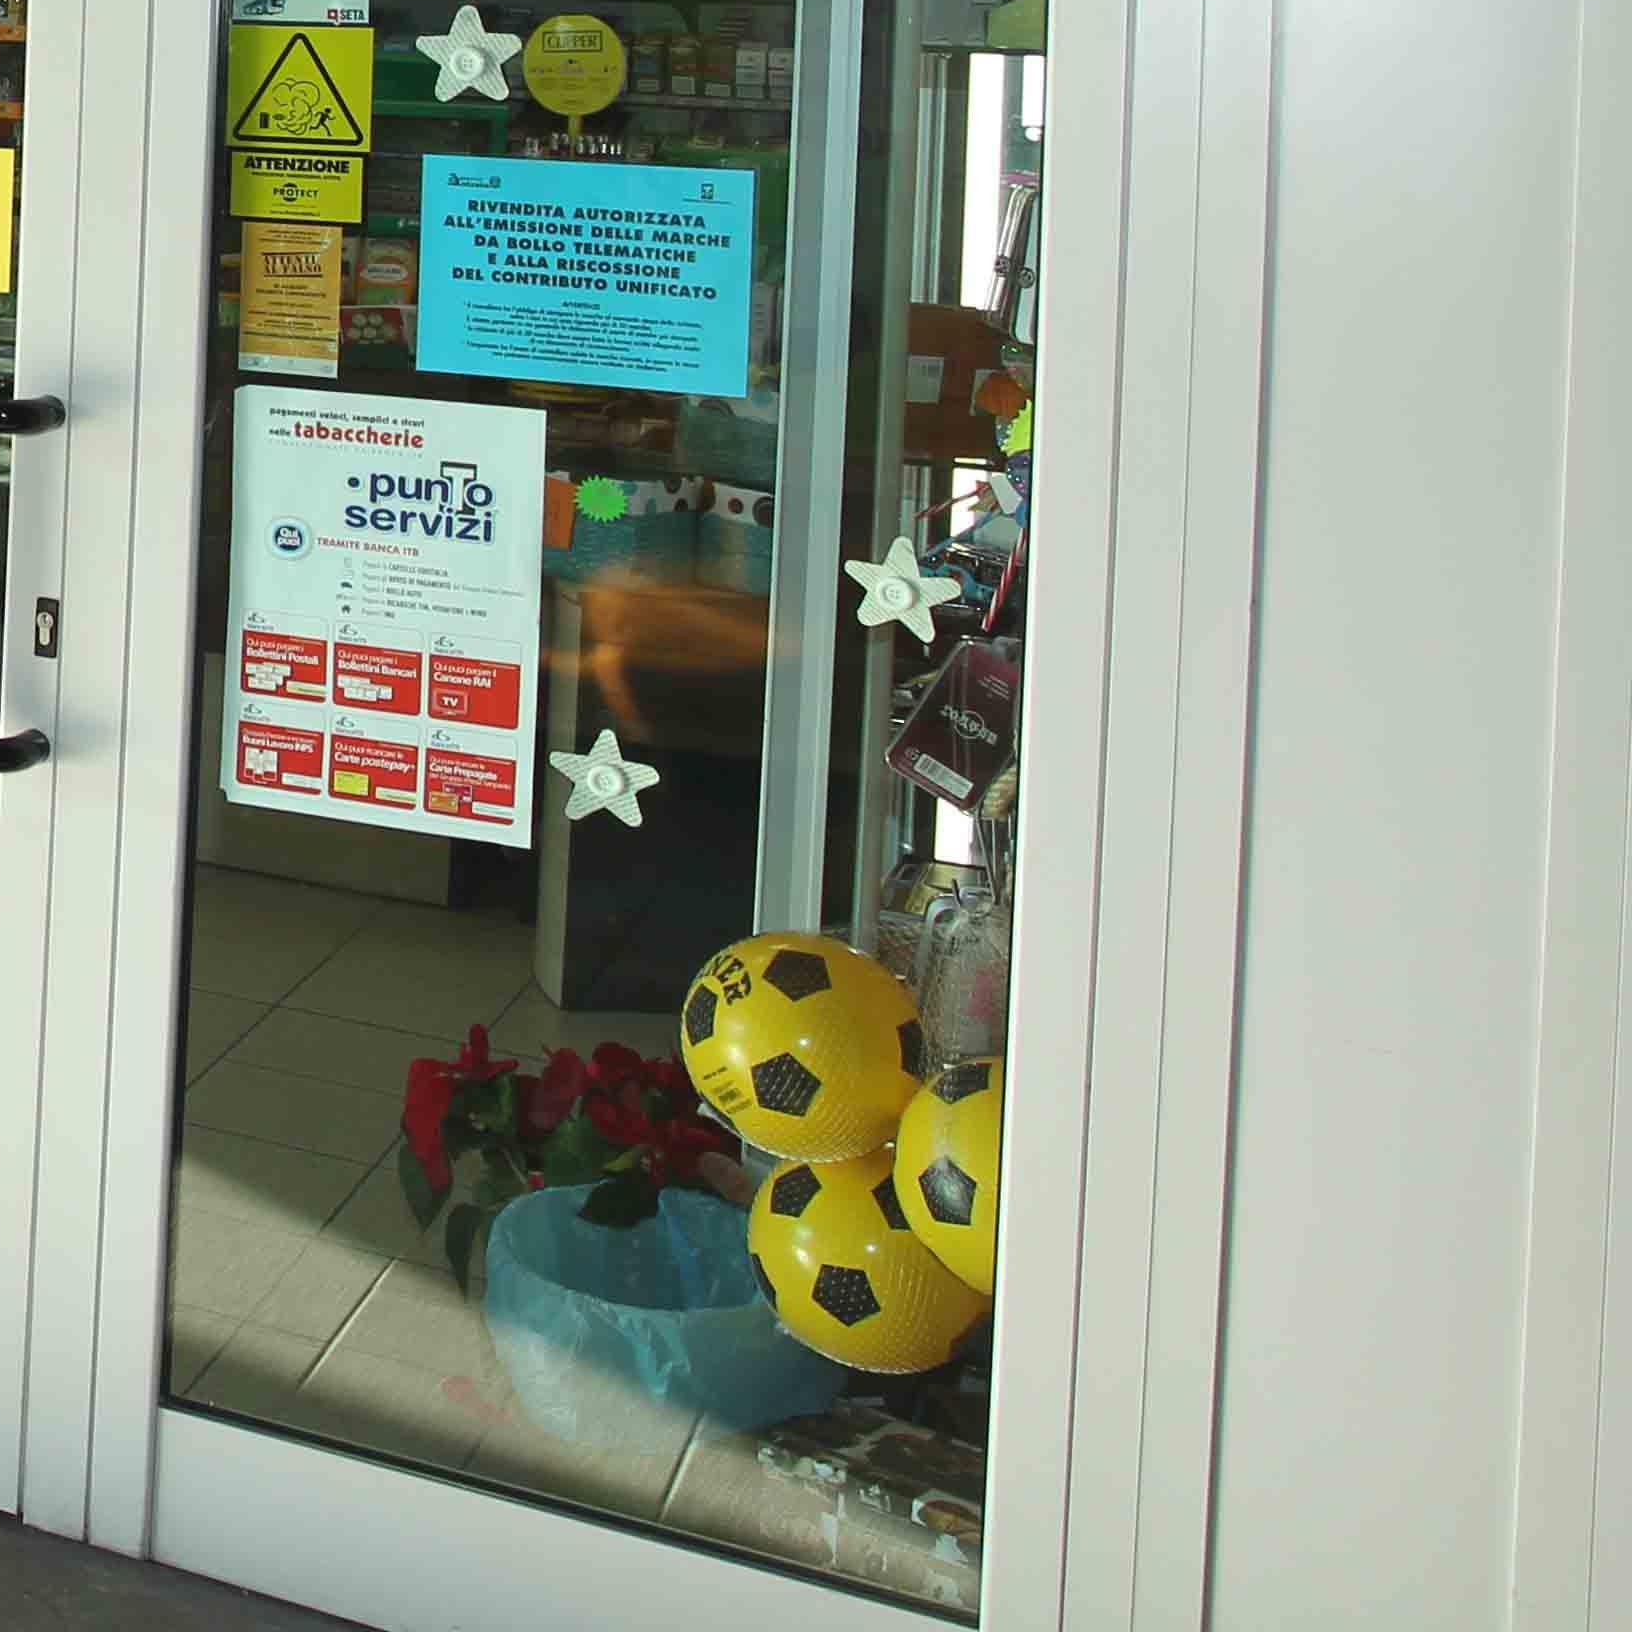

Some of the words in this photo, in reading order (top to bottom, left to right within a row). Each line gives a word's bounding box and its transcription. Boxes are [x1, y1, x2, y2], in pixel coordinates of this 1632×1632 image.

[339, 9, 365, 20] SETA
[244, 156, 350, 174] ATTENZIONE
[468, 199, 564, 219] RIVENDITA
[574, 208, 705, 228] AUTORIZZATA
[444, 215, 583, 237] ALL'EMISSIONE
[591, 226, 643, 242] DELLE
[652, 231, 731, 248] MARCHE
[474, 236, 501, 249] DA
[507, 237, 565, 253] BOLLO
[574, 243, 696, 263] TELEMATICHE
[488, 253, 496, 265] E
[504, 254, 548, 269] ALLA
[557, 258, 681, 279] RISCOSSIONE
[452, 267, 484, 281] DEL
[492, 270, 608, 291] CONTRIBUTO
[616, 279, 717, 300] UNIFICATO
[269, 407, 316, 420] pagamenti
[352, 414, 389, 427] semplici
[401, 418, 425, 428] sicuri
[294, 421, 424, 449] tabaccherie
[345, 505, 492, 543] servizi
[317, 537, 360, 551] TRAMITE
[364, 542, 400, 555] BANCA
[442, 697, 458, 707] TV
